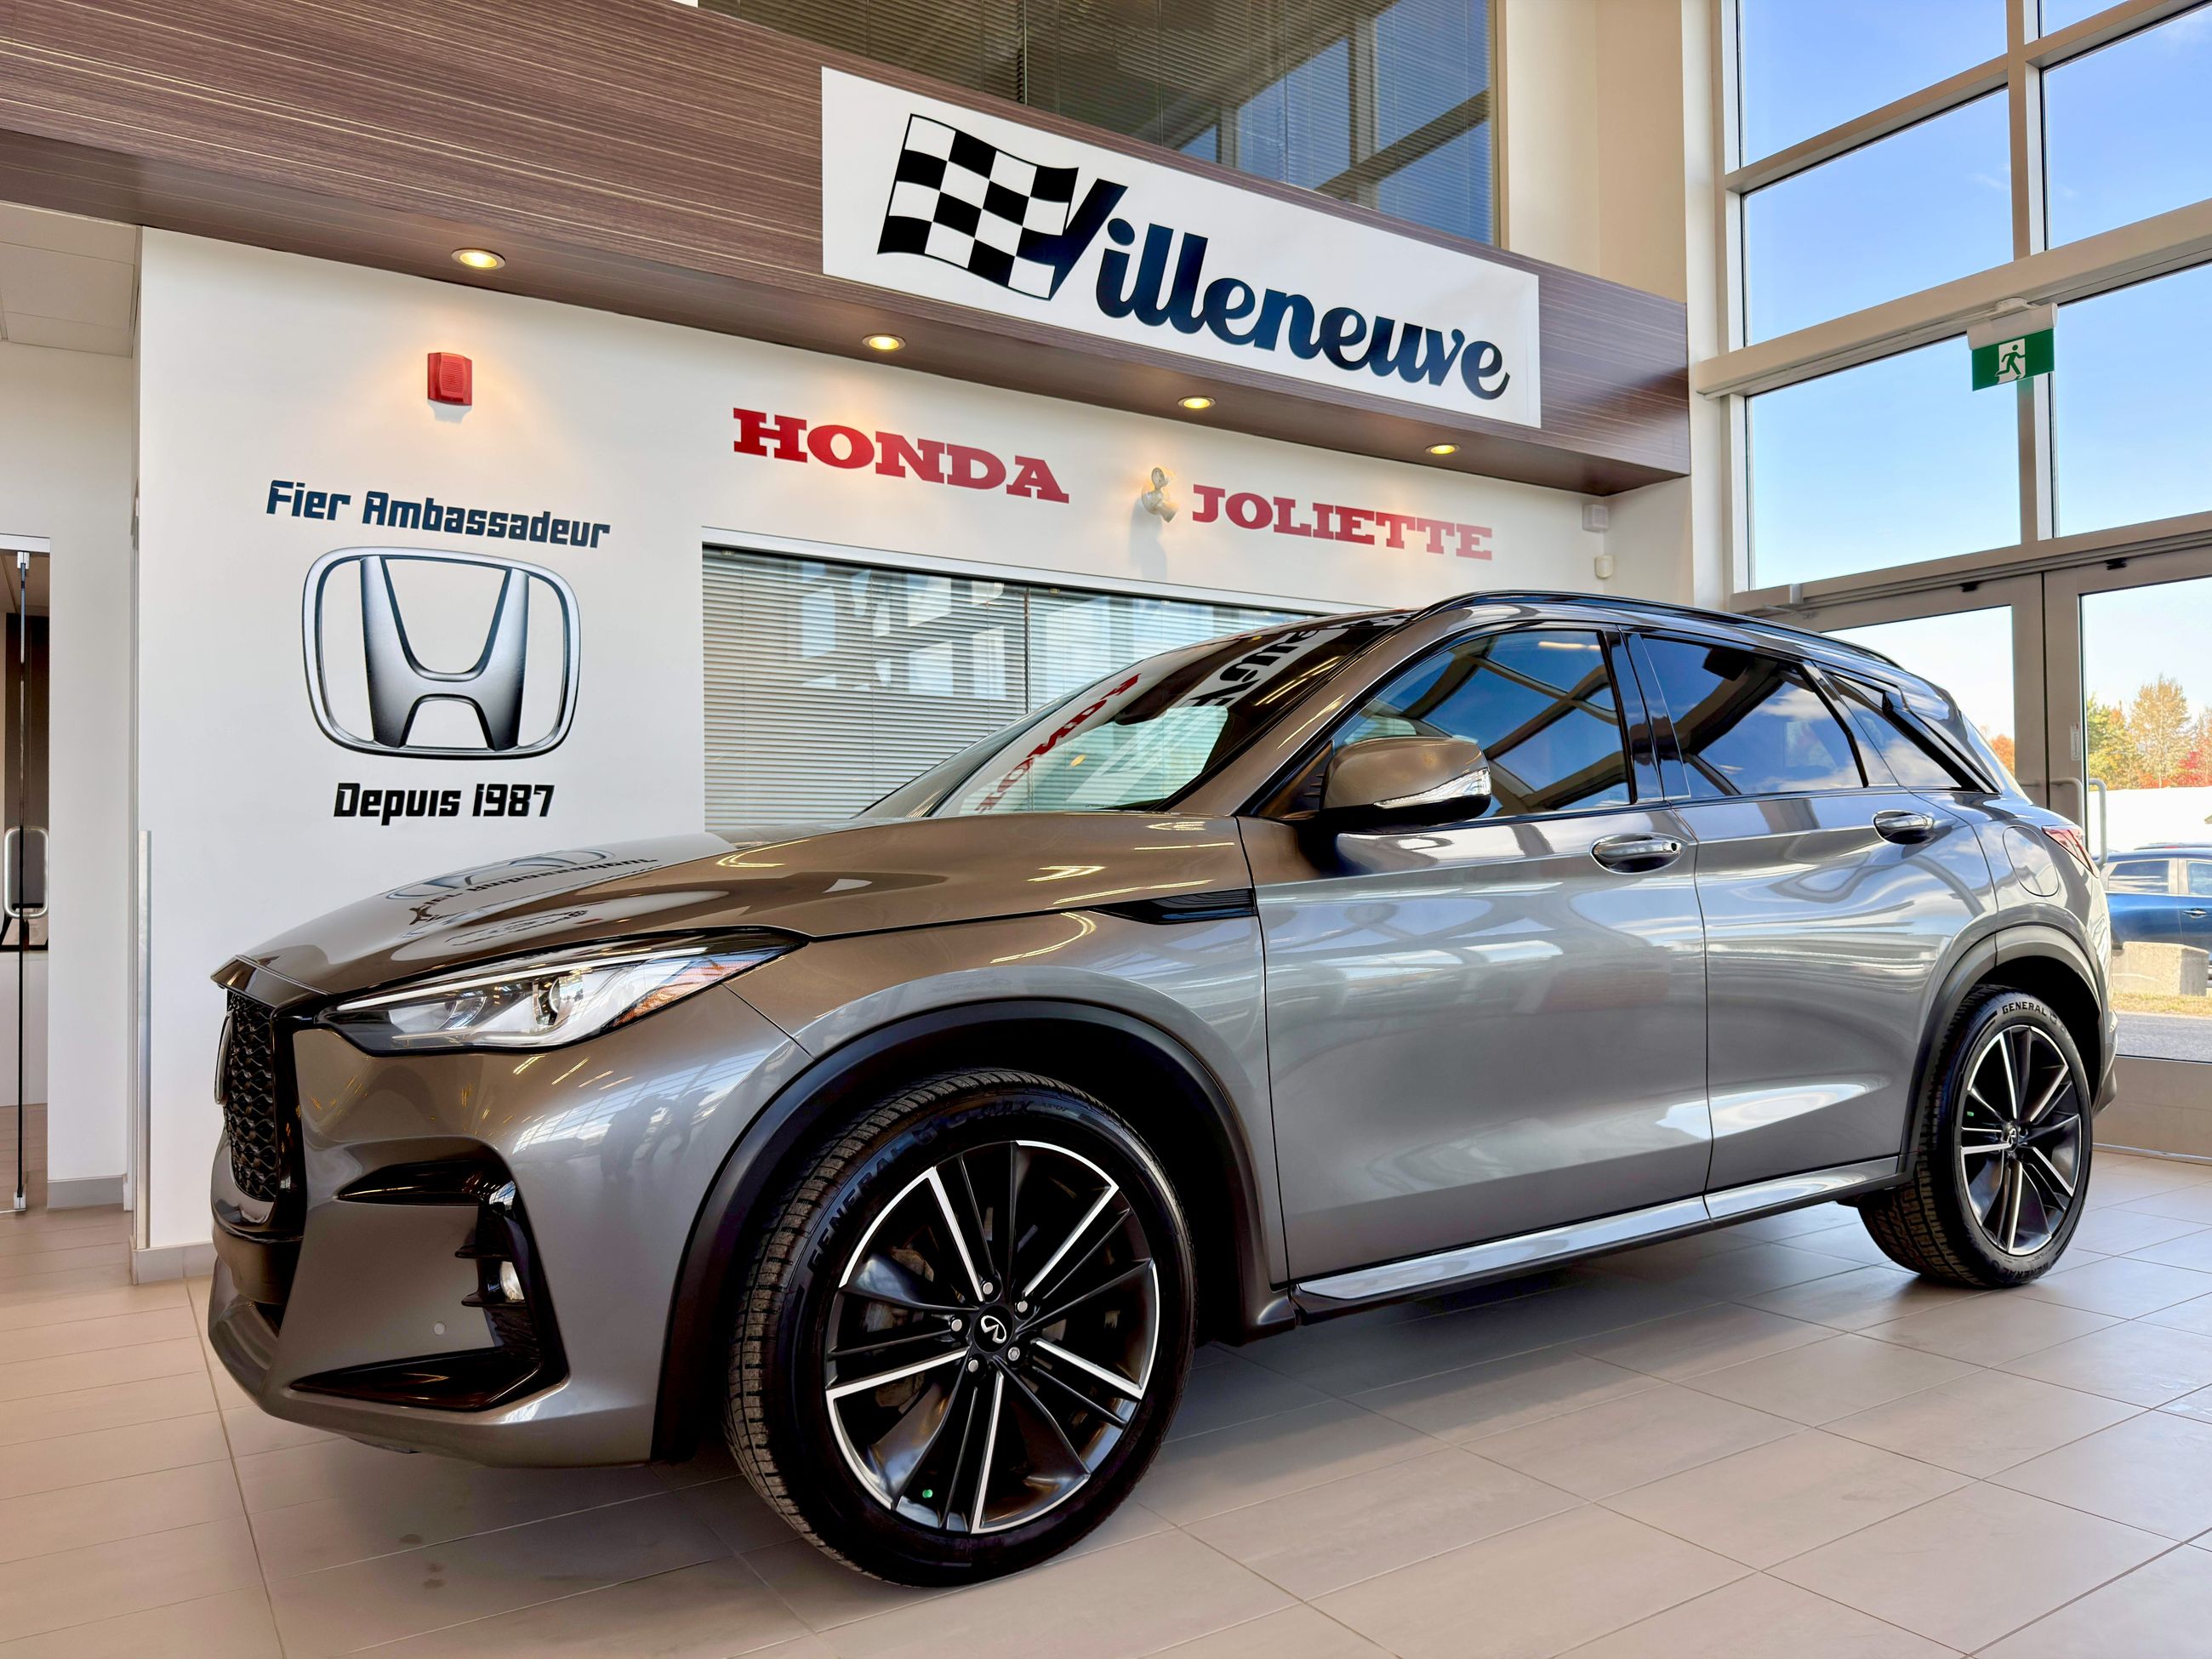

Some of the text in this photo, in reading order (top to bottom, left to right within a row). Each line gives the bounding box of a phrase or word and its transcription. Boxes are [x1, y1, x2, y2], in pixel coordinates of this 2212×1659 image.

[1016, 177, 1510, 400] Villeneuve
[733, 408, 1069, 504] HONDA
[265, 479, 611, 549] Fier Ambassadeur
[1192, 484, 1493, 562] JOLIETTE
[333, 782, 556, 826] Depuis 1987
[2002, 1001, 2048, 1017] GENERAL
[807, 1143, 906, 1274] GENERAL
